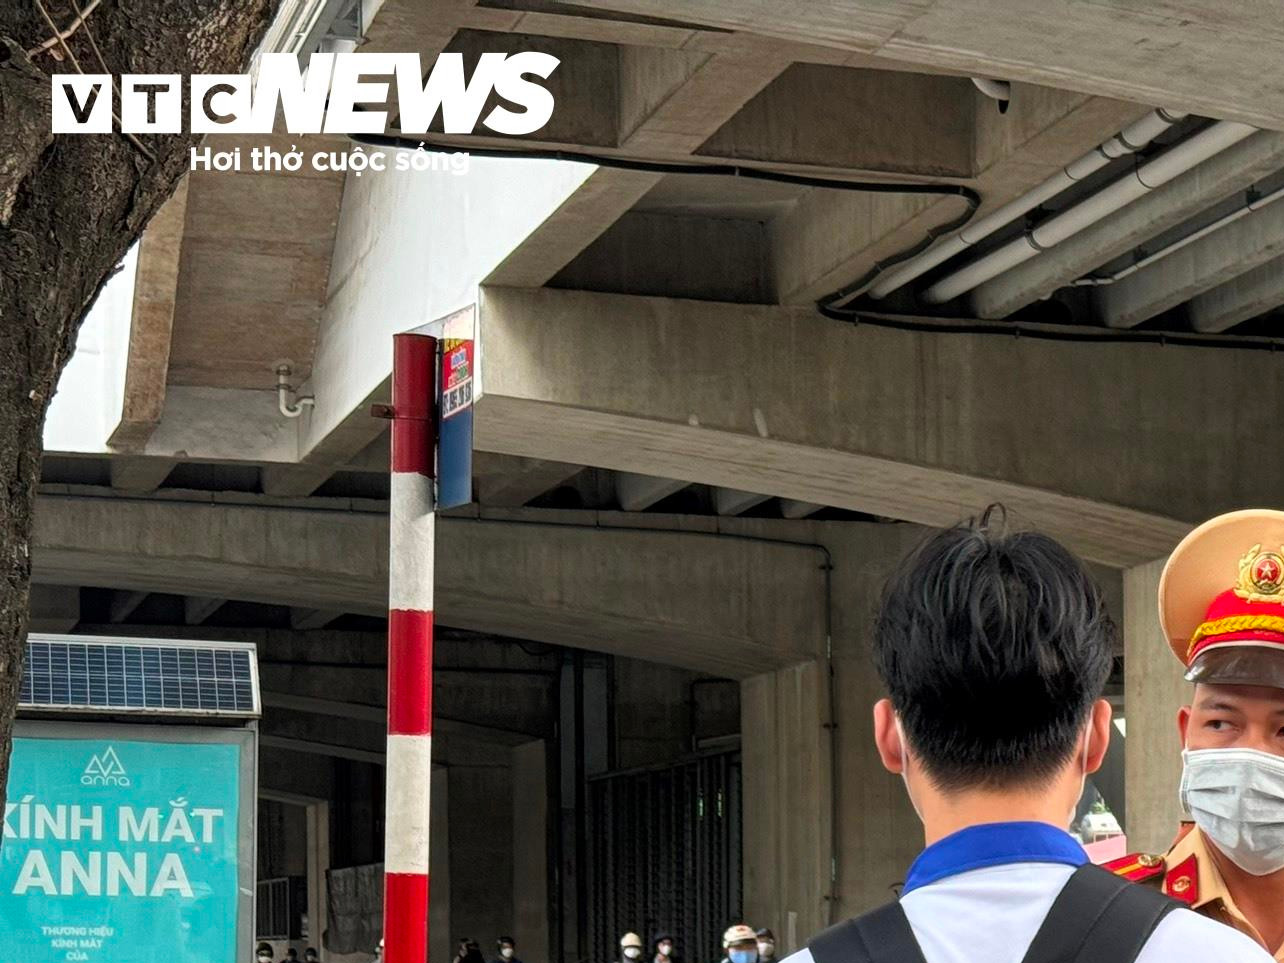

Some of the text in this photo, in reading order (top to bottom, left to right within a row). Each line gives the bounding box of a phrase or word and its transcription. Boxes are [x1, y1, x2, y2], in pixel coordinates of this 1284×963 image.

[80, 774, 130, 787] anna
[118, 796, 224, 843] MẮT
[12, 849, 195, 898] ANNA
